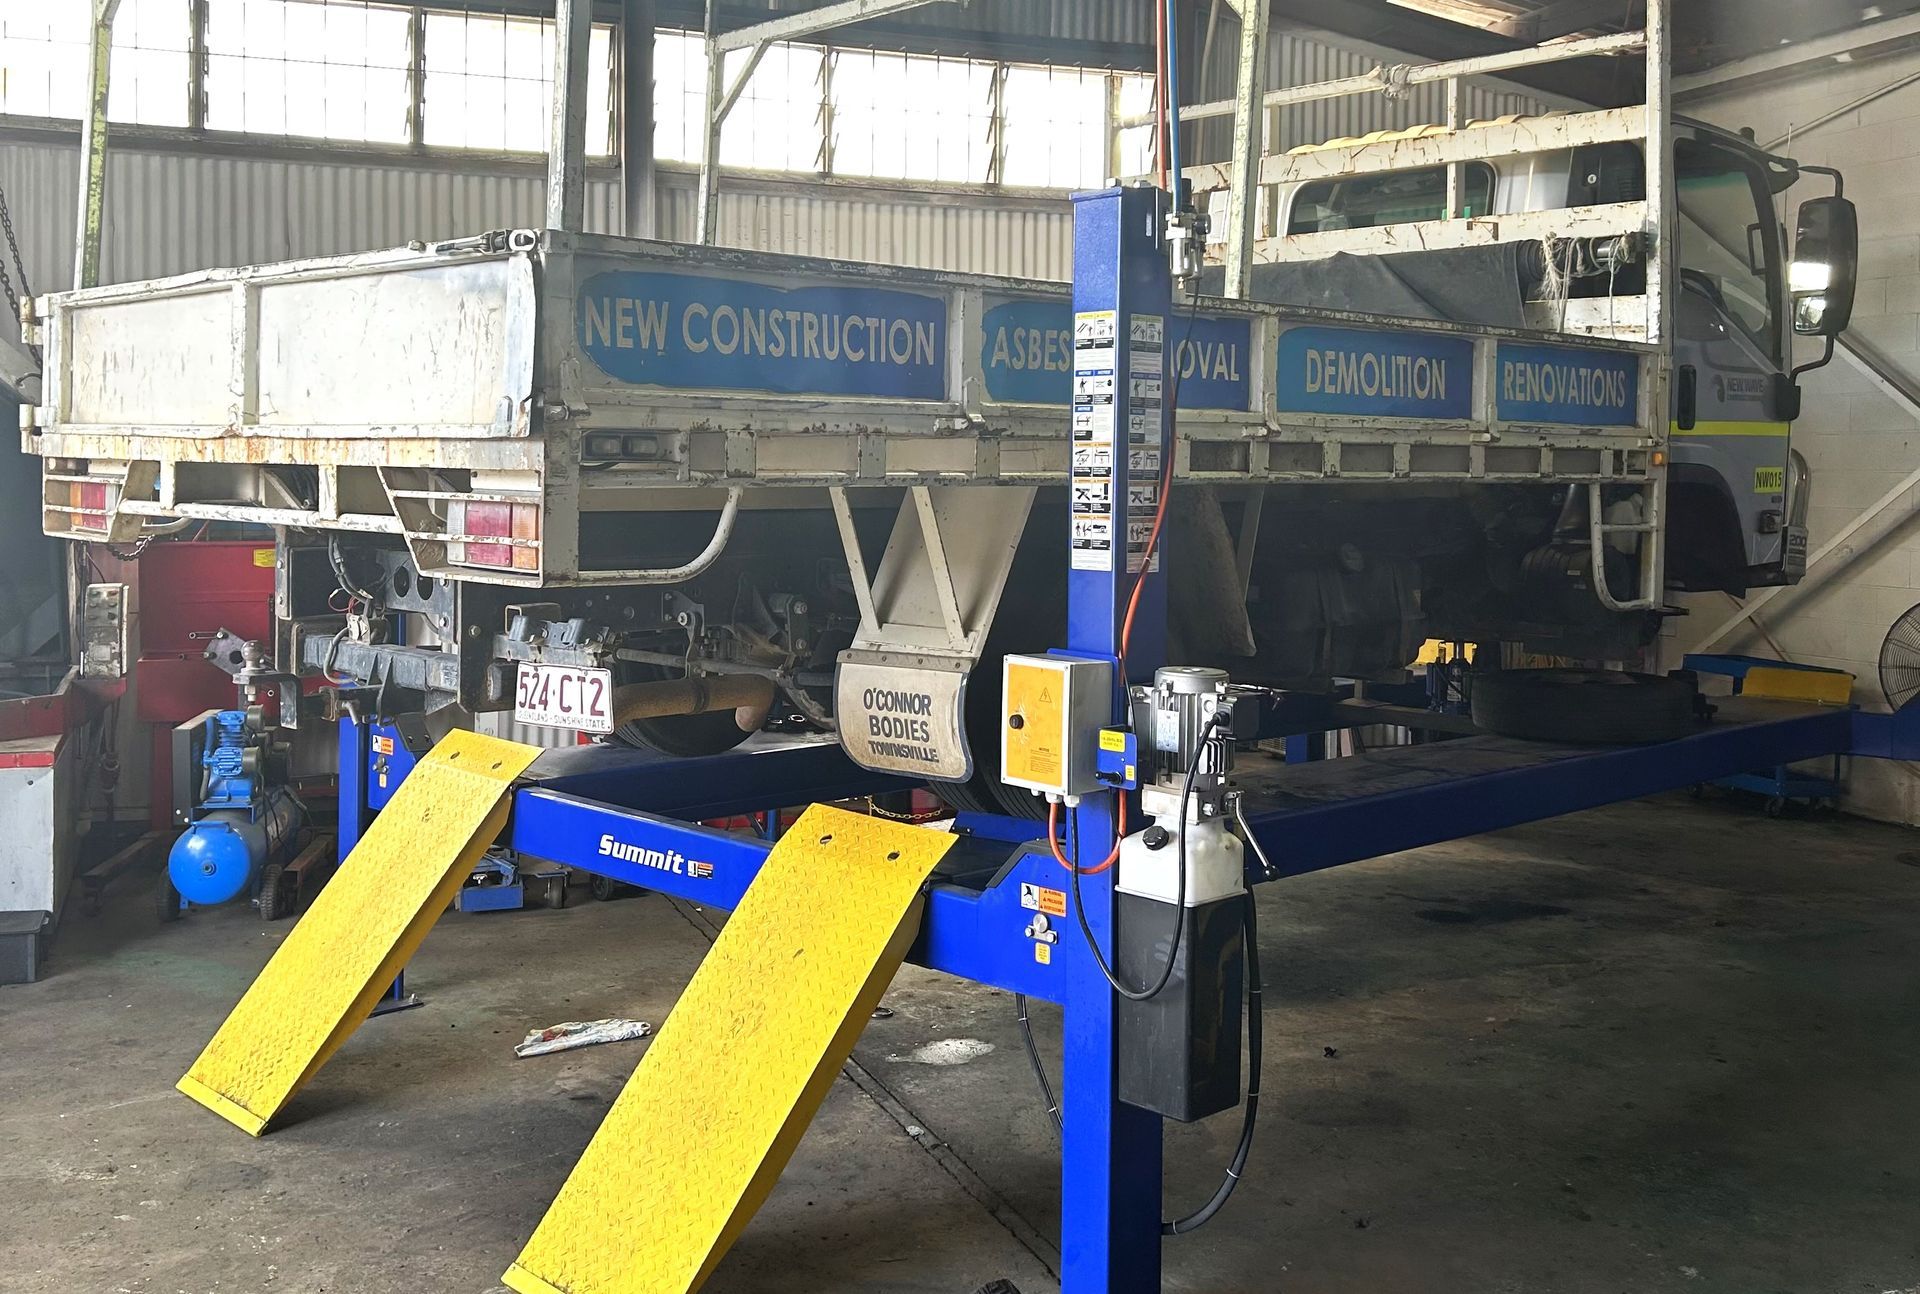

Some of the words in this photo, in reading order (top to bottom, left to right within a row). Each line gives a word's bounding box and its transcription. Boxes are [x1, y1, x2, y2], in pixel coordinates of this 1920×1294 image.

[584, 296, 669, 351] NEW
[682, 302, 935, 366] CONSTRUCTION
[990, 326, 1072, 373] ASBES
[1170, 338, 1240, 381] OVAL
[1305, 349, 1447, 400] DEMOLITION
[1503, 361, 1626, 408] RENOVATIONS
[1756, 471, 1782, 489] NW015
[863, 687, 932, 716] O'CONNOR
[585, 718, 606, 730] STATE
[868, 714, 930, 743] BODIES
[867, 740, 940, 764] TOWNSVILLE
[598, 834, 685, 875] Summit
